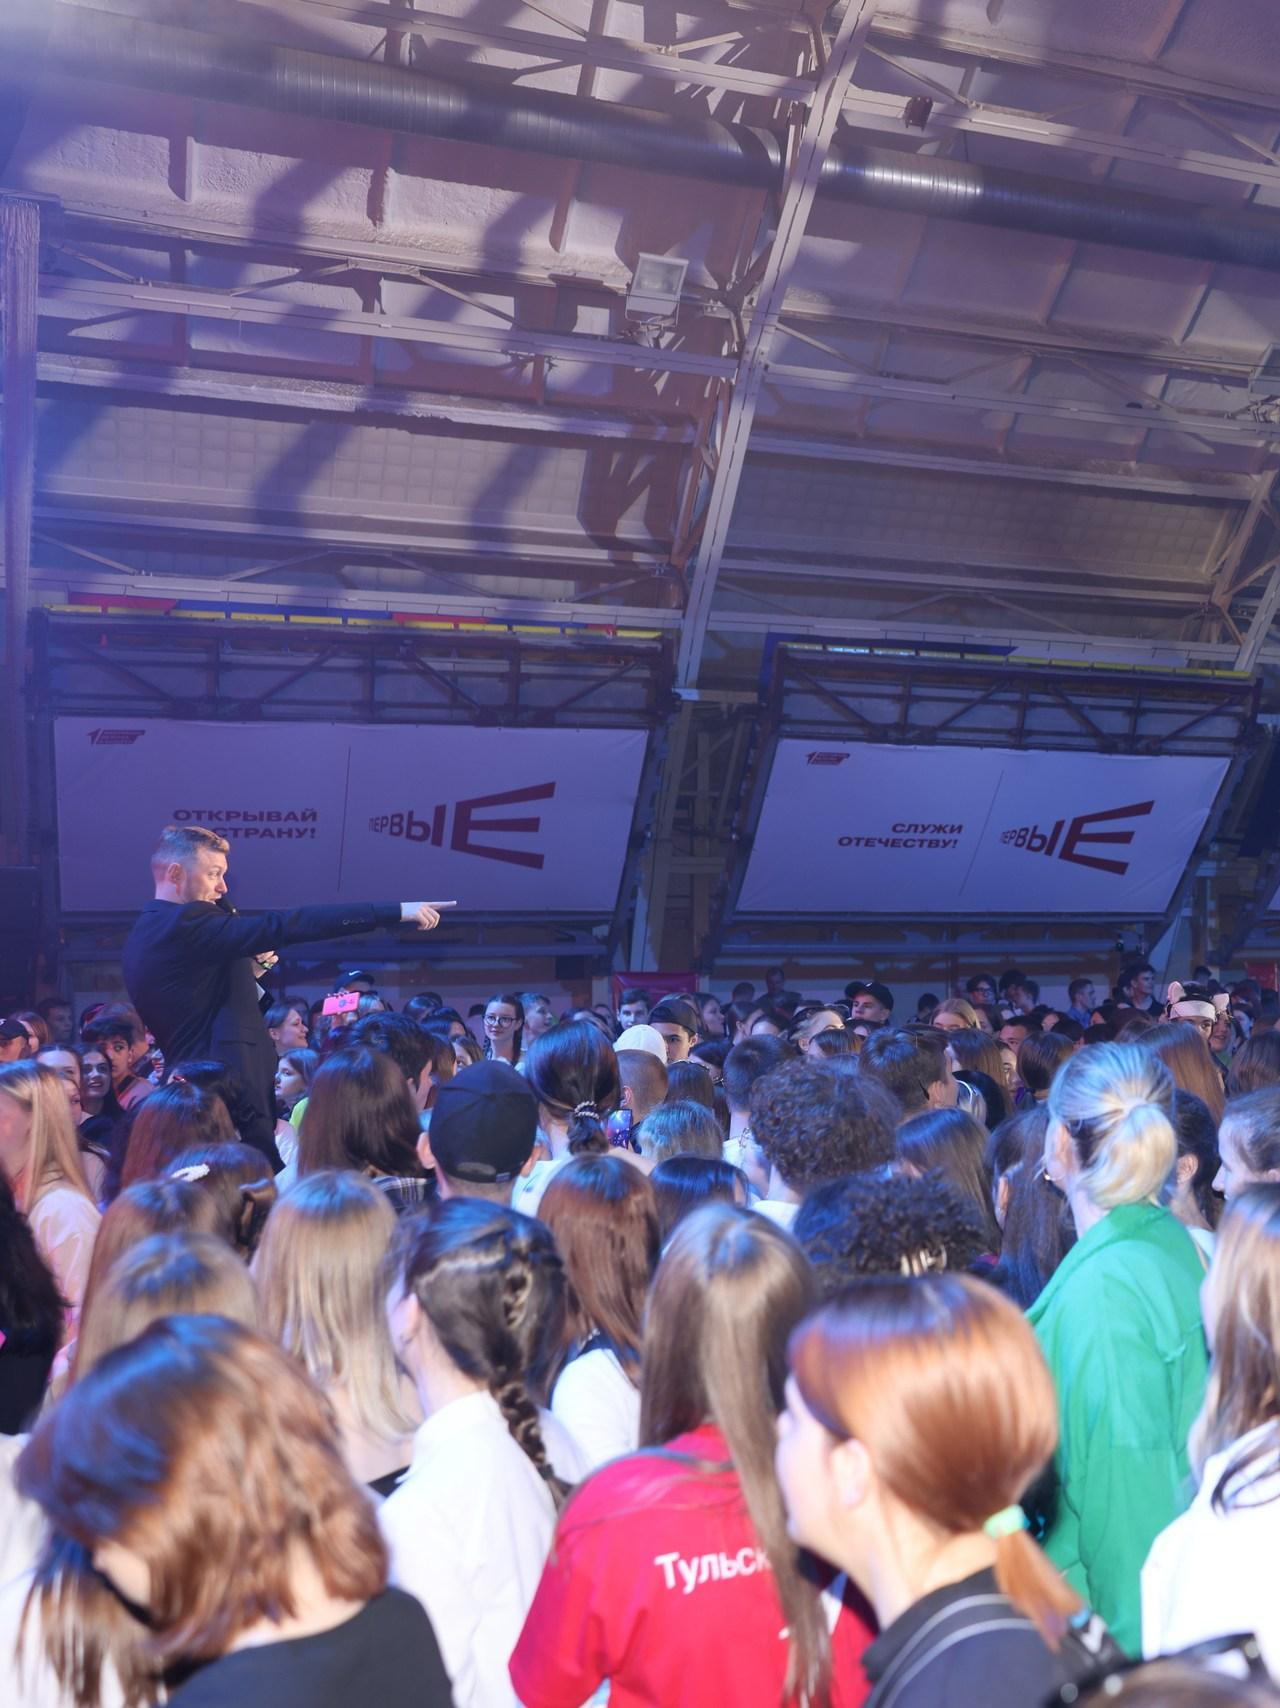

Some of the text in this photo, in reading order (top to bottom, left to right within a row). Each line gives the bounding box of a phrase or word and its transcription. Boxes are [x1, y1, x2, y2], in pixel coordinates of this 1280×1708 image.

[173, 808, 317, 822] ОТКРЫВАЙ
[368, 781, 556, 870] ПЕРВЫЕ
[891, 823, 963, 834] СЛУЖИ
[214, 827, 316, 839] СТРАНУ!
[838, 836, 958, 848] ОТЕЧЕСТВУ!
